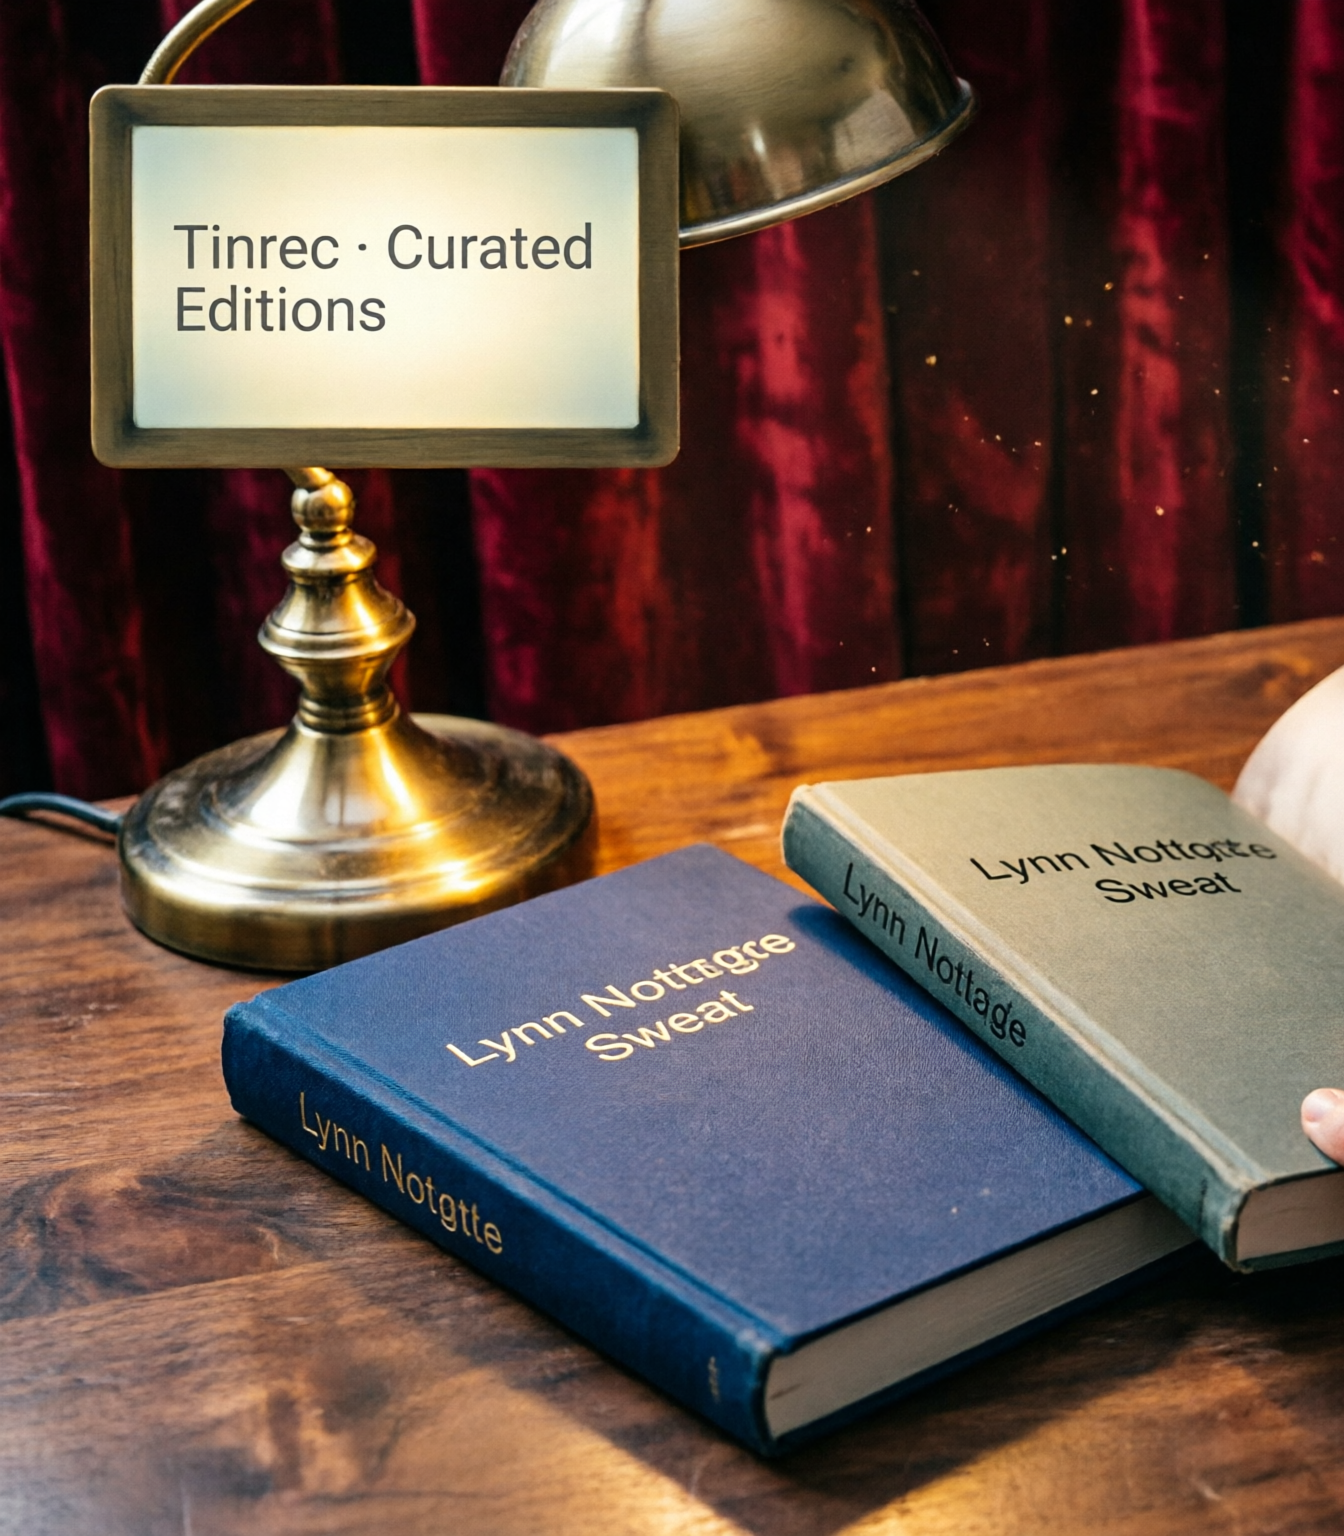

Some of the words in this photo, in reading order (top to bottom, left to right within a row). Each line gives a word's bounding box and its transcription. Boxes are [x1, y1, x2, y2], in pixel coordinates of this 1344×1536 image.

[173, 224, 340, 270] Tinrec
[387, 221, 593, 271] Curated
[175, 283, 387, 332] Editions
[969, 848, 1090, 885] Lynn
[1094, 871, 1242, 904] Sweat
[842, 862, 906, 946] Lynn
[913, 925, 1027, 1048] Nottage
[445, 1009, 586, 1068] Lynn
[584, 989, 755, 1062] Sweat
[300, 1091, 371, 1172] Lynn
